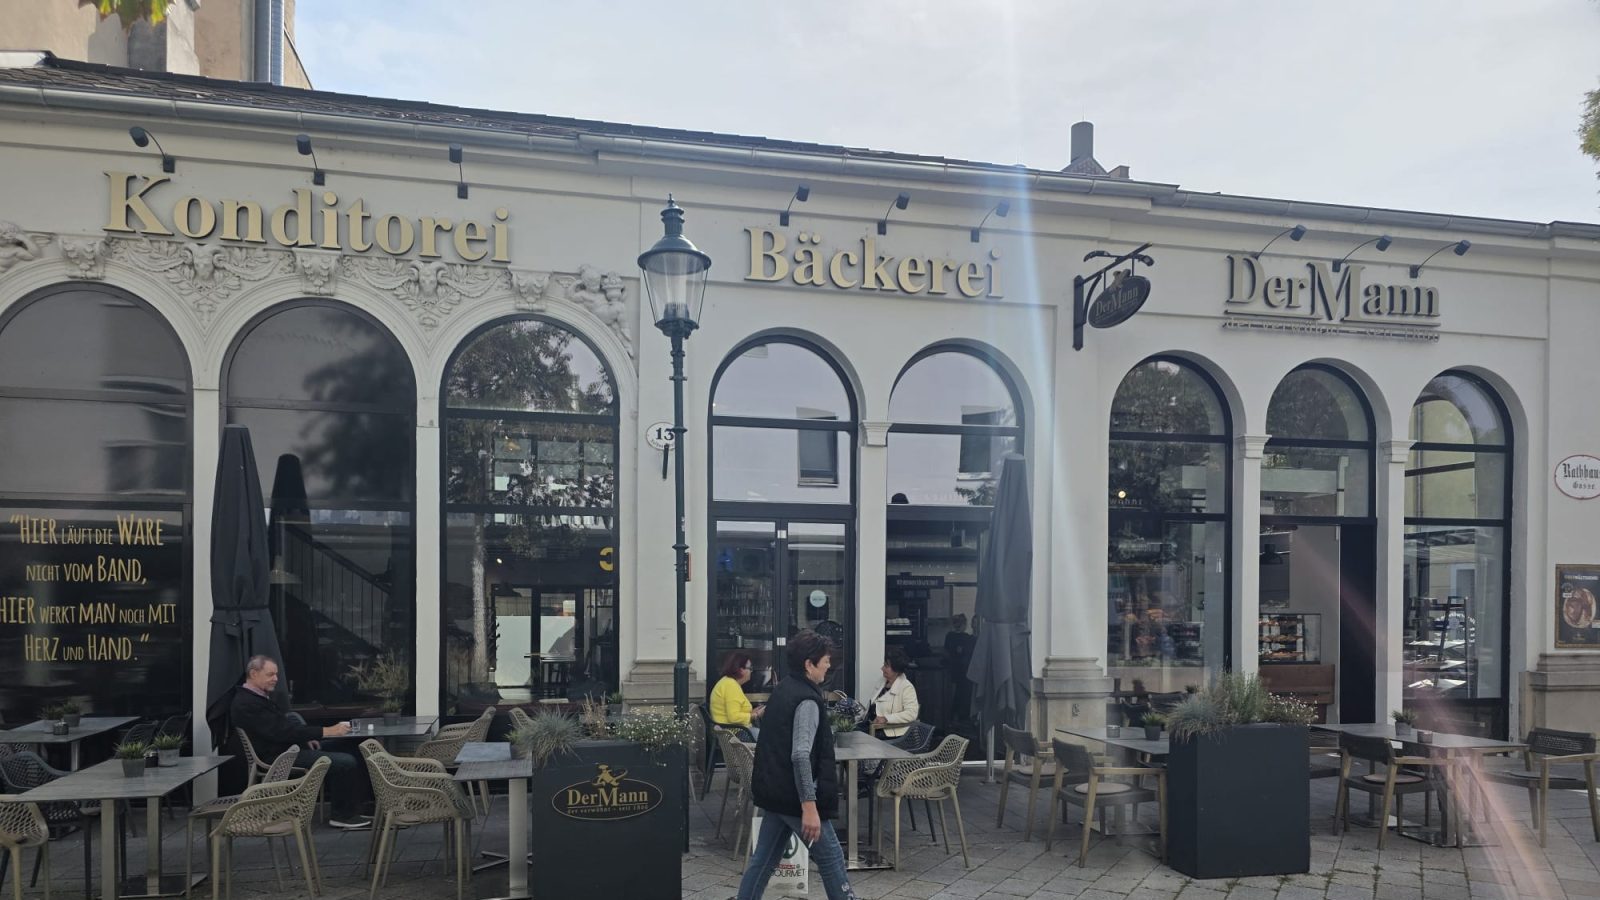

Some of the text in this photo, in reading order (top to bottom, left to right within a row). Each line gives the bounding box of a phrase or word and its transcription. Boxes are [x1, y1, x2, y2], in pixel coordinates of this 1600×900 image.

[102, 170, 512, 263] Konditorei
[744, 227, 1004, 298] Bäckerei
[655, 427, 675, 441] 13
[1562, 463, 1600, 478] Rathhau
[61, 525, 93, 545] LÄUFT
[95, 528, 113, 545] DIE
[117, 514, 164, 546] WARE
[26, 555, 147, 585] NICHT VOM BAND,
[0, 597, 176, 625] HIER WERKT MAN NOCH MIT
[24, 634, 60, 661] HERZ
[63, 646, 84, 661] UND
